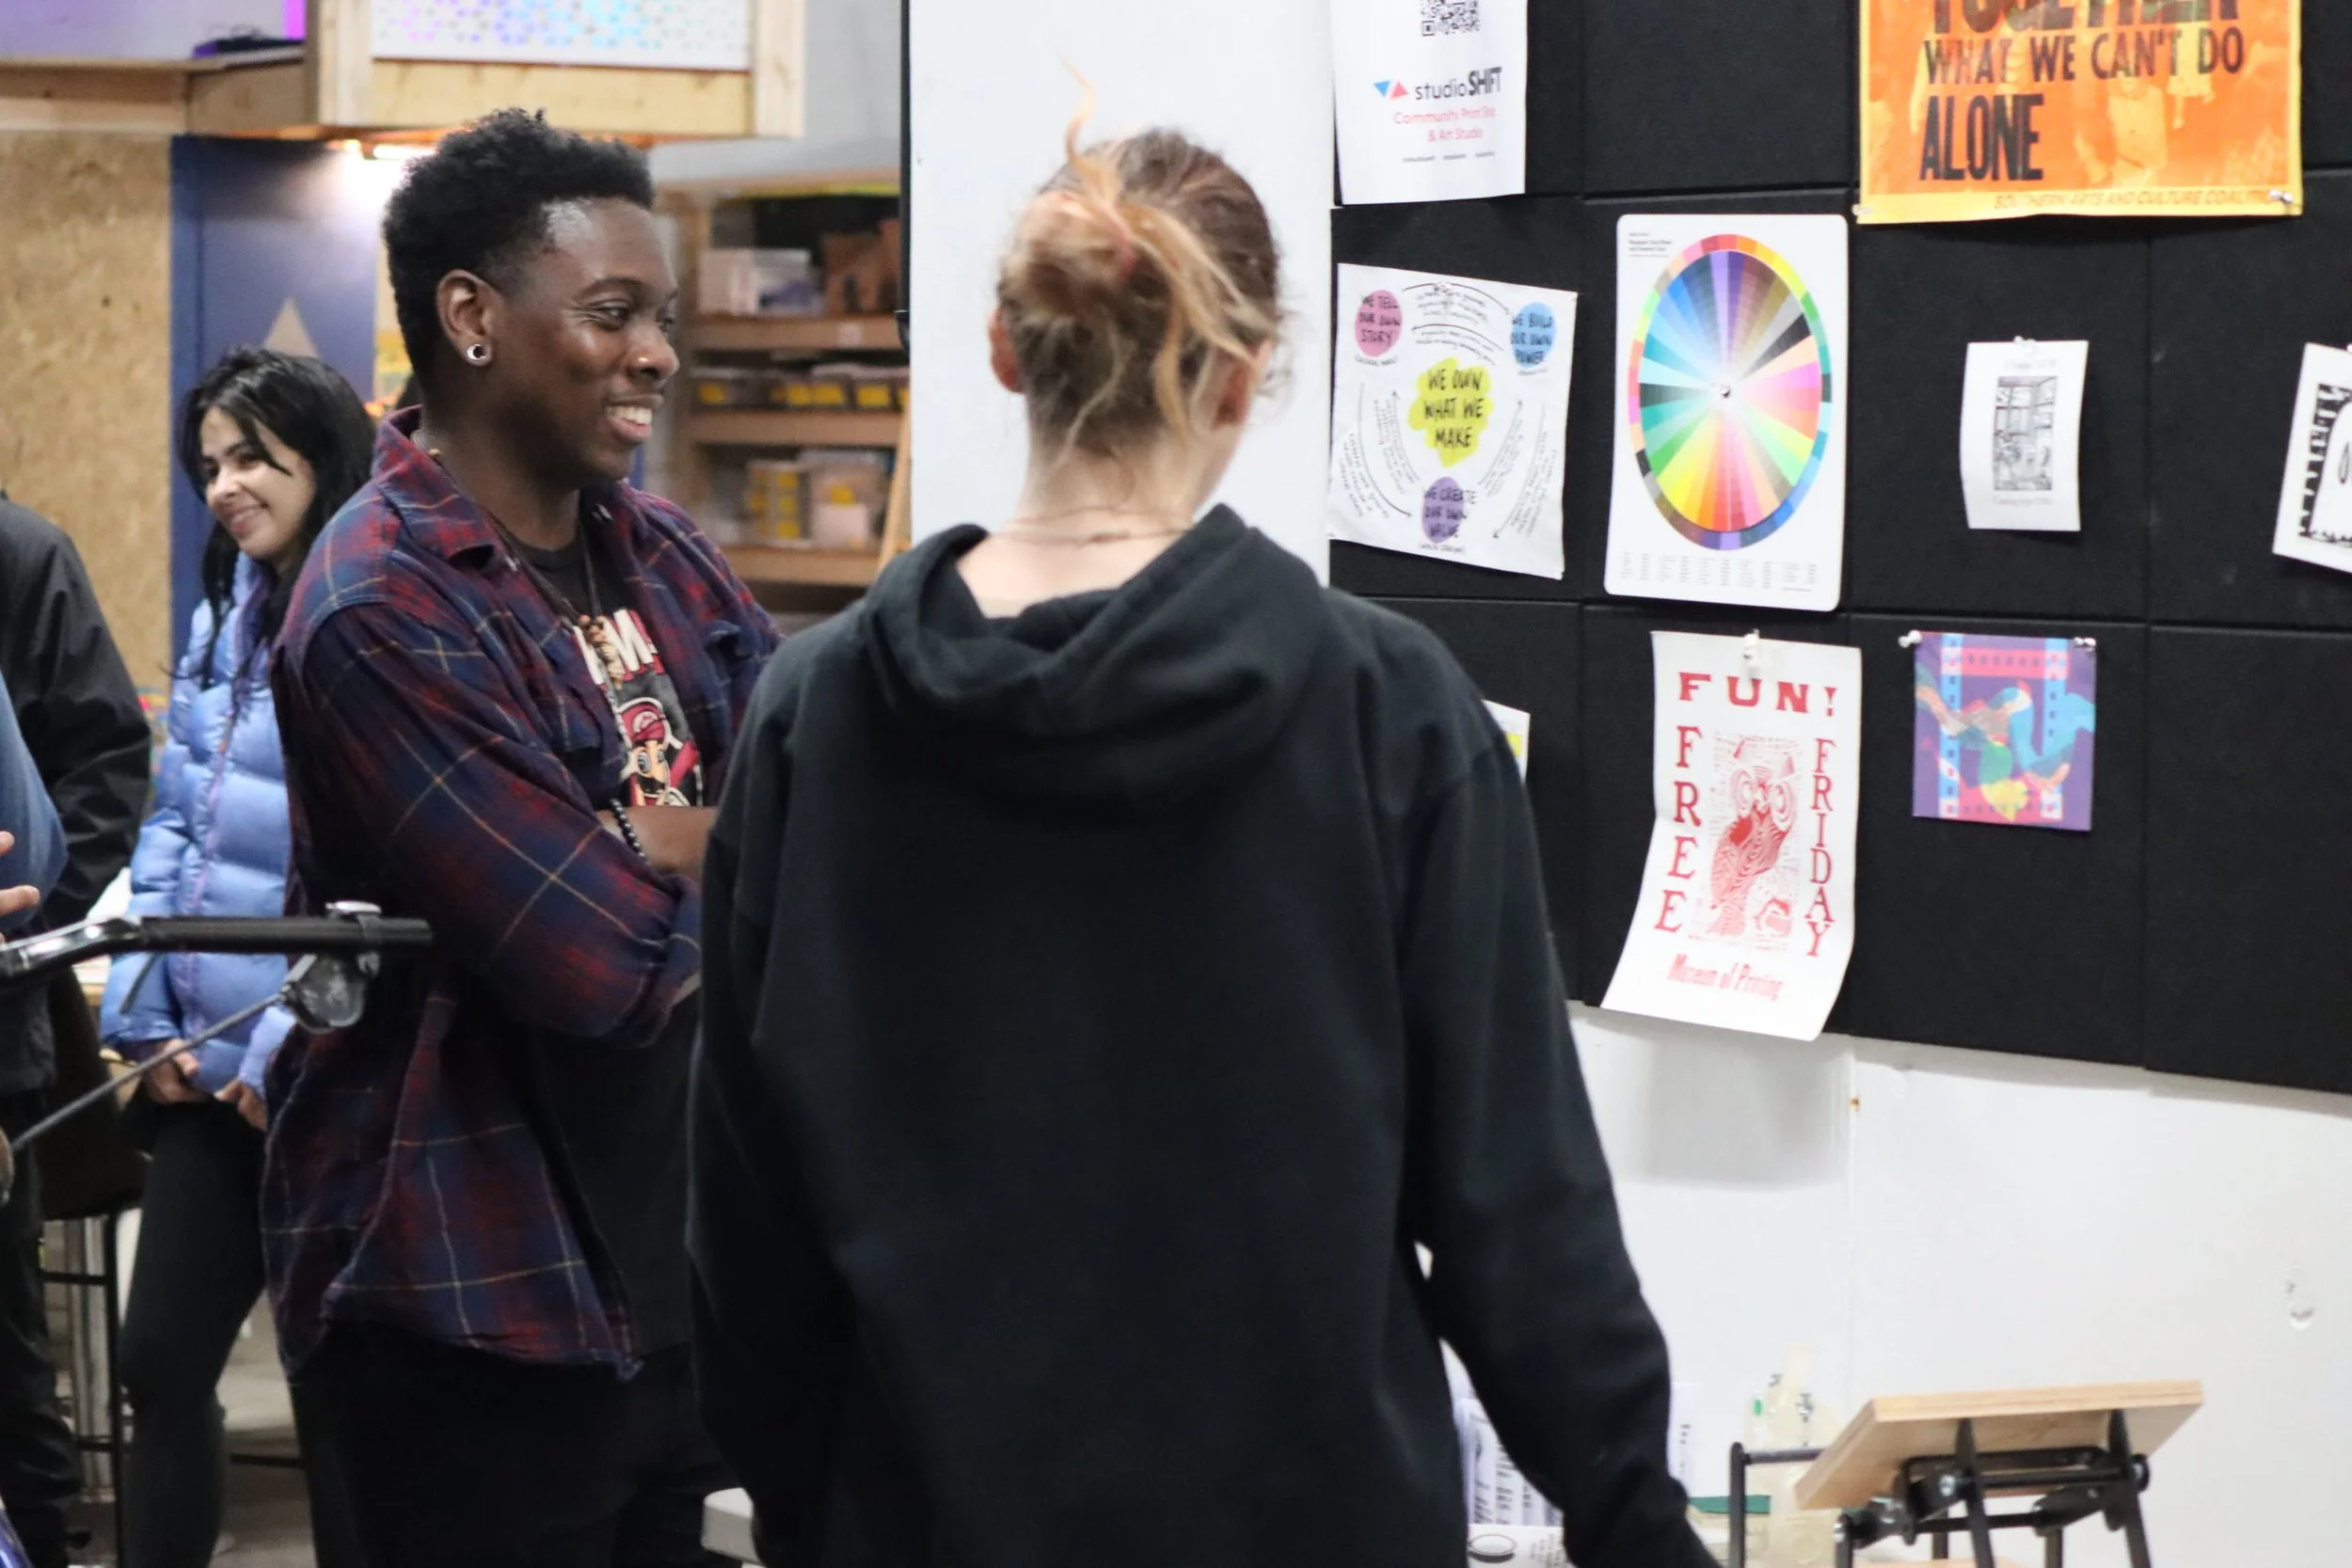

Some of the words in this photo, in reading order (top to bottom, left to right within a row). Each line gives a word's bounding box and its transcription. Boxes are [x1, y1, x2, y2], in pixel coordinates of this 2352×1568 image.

[1924, 38, 2011, 85] WHAT
[2029, 35, 2075, 82] WE
[2090, 29, 2182, 80] CAN'T
[2197, 26, 2243, 74] DO
[1918, 93, 2044, 181] ALONE
[1426, 369, 1448, 390] WE
[1452, 368, 1484, 391] OWN
[1423, 397, 1457, 421] WHAT
[1462, 397, 1486, 420] WE
[1435, 426, 1473, 449] MAKE
[1679, 672, 1838, 717] FUN!
[1654, 725, 1704, 934] FREE
[1804, 738, 1837, 958] FRIDAY
